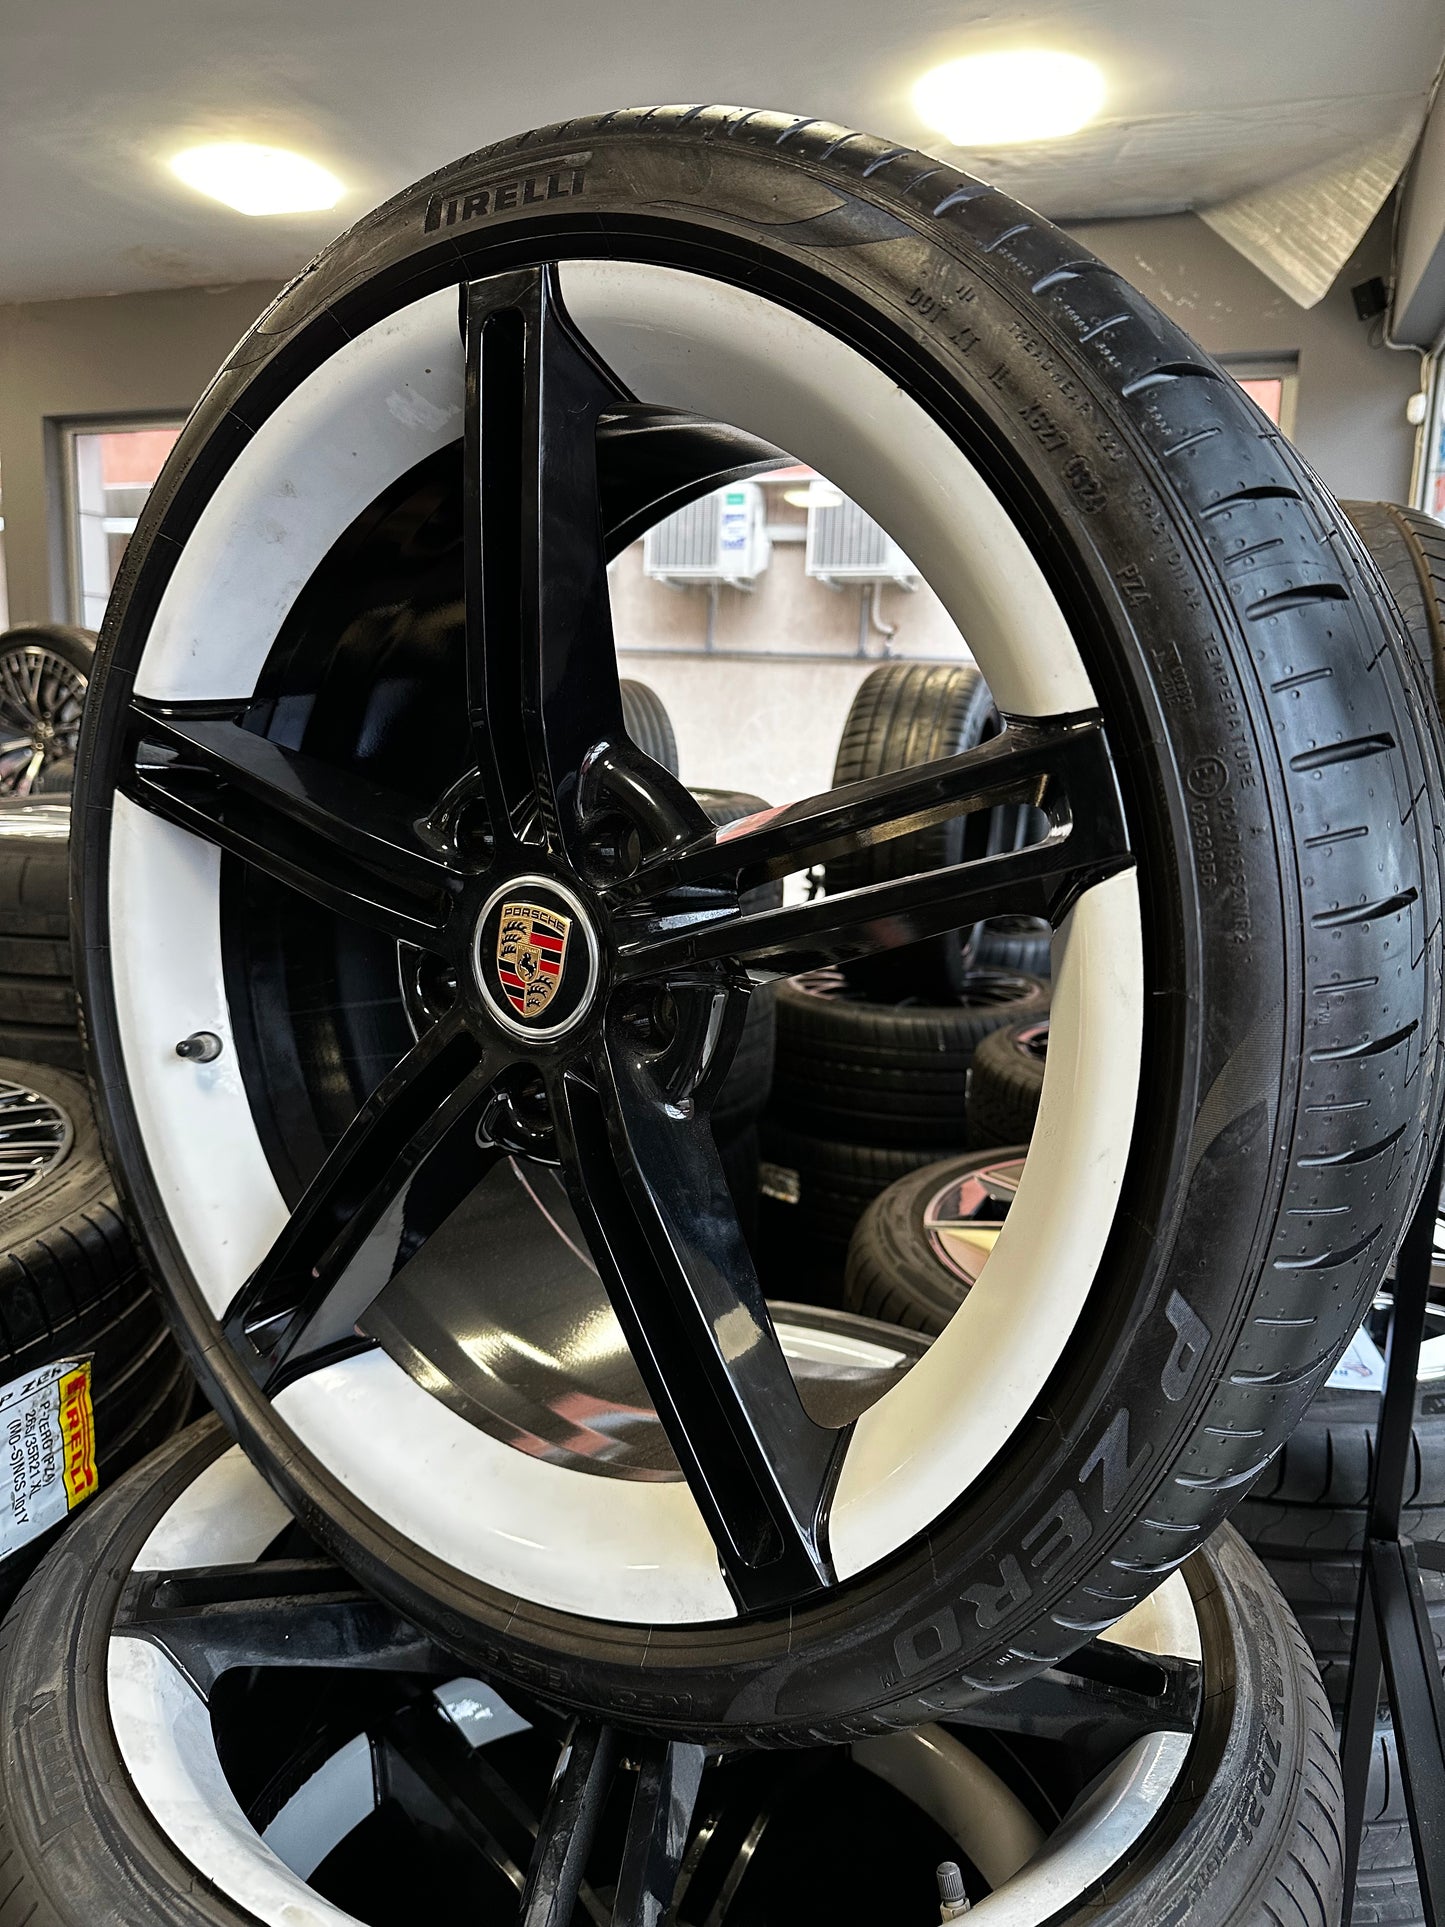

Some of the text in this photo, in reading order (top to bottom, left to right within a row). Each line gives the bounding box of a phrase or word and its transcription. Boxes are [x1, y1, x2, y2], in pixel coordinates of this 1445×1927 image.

[424, 151, 593, 234] PIRELLI
[1008, 321, 1094, 417] TREADWEAR
[1129, 484, 1190, 582] TRACTION
[1201, 632, 1256, 790] TEMPERATURE
[1116, 563, 1151, 609] PZ4
[504, 907, 566, 934] PORSCHE
[1160, 1288, 1213, 1402] P
[6, 1418, 30, 1526] (MO-S)NCS 101Y
[24, 1408, 42, 1500] 265/35R21 XL
[39, 1401, 57, 1488] P-ZERO (PZ4)
[67, 1373, 94, 1495] PIRELLI
[893, 1407, 1154, 1678] ZERO
